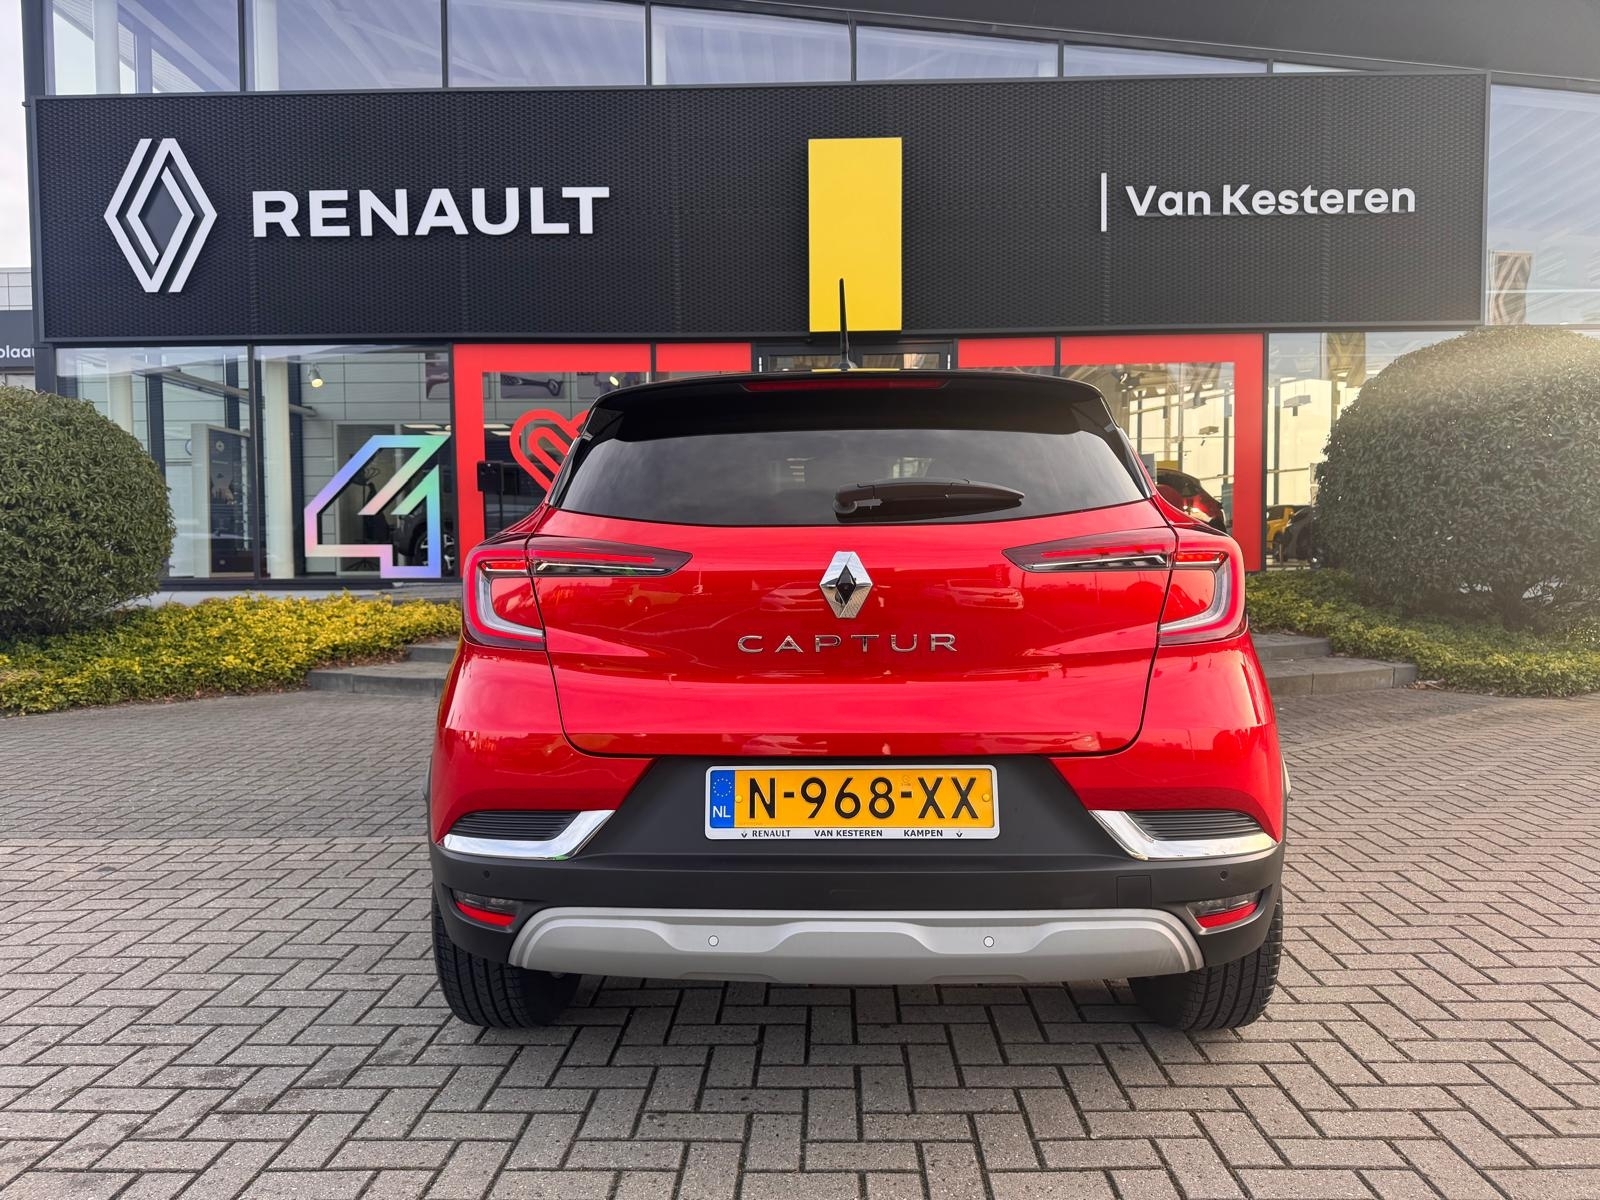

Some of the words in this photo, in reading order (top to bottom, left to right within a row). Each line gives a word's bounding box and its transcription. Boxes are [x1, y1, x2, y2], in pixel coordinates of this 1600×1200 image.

[252, 186, 610, 238] RENAULT
[1125, 184, 1211, 217] Van
[1222, 183, 1416, 216] Kesteren
[737, 633, 958, 653] CAPTUR
[748, 776, 979, 820] N-968-XX
[712, 805, 731, 819] NL
[752, 829, 791, 838] RENAULT
[814, 829, 834, 838] VAN
[836, 829, 883, 838] KESTEREN
[903, 829, 943, 838] KAMPEN
